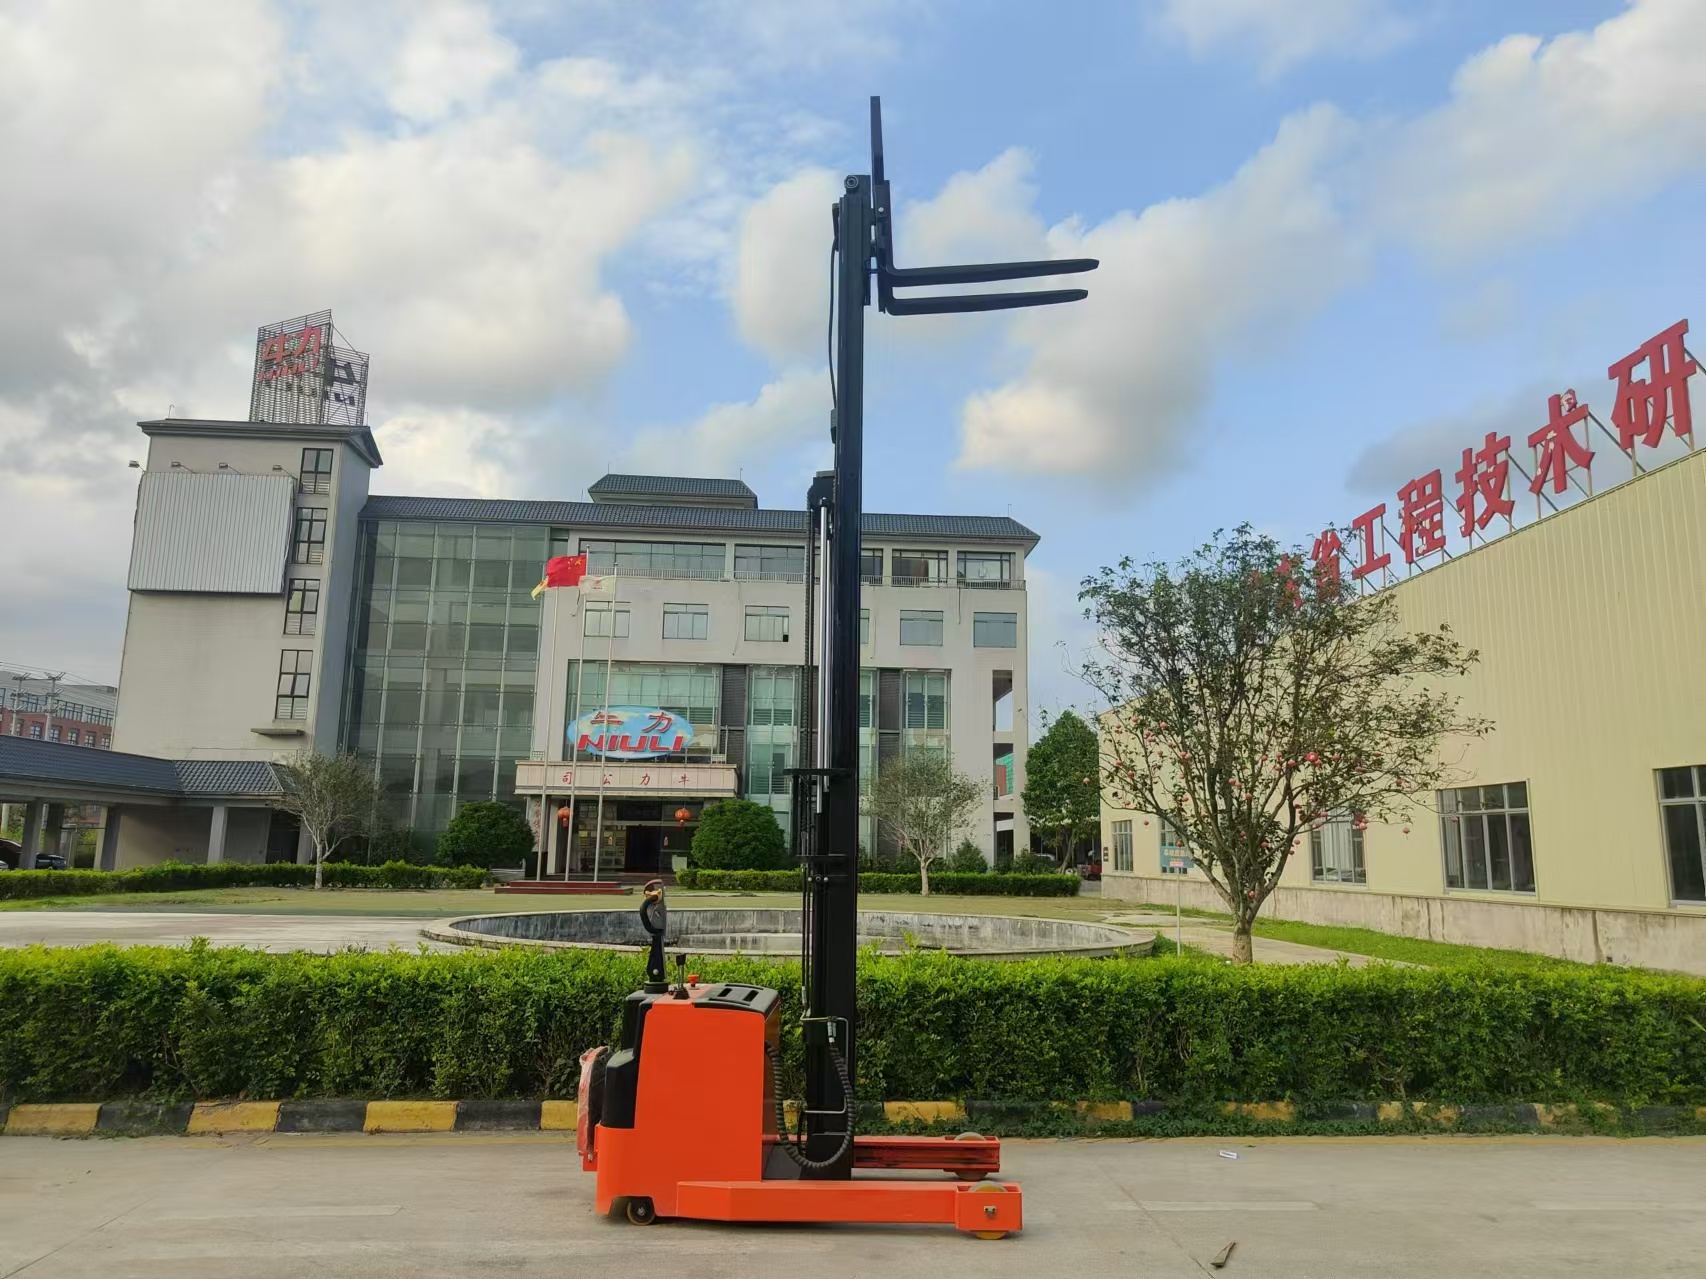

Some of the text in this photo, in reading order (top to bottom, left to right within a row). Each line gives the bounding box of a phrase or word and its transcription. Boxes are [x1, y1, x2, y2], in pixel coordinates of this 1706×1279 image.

[1275, 319, 1697, 608] 省工程技术研
[577, 734, 683, 751] NIULI
